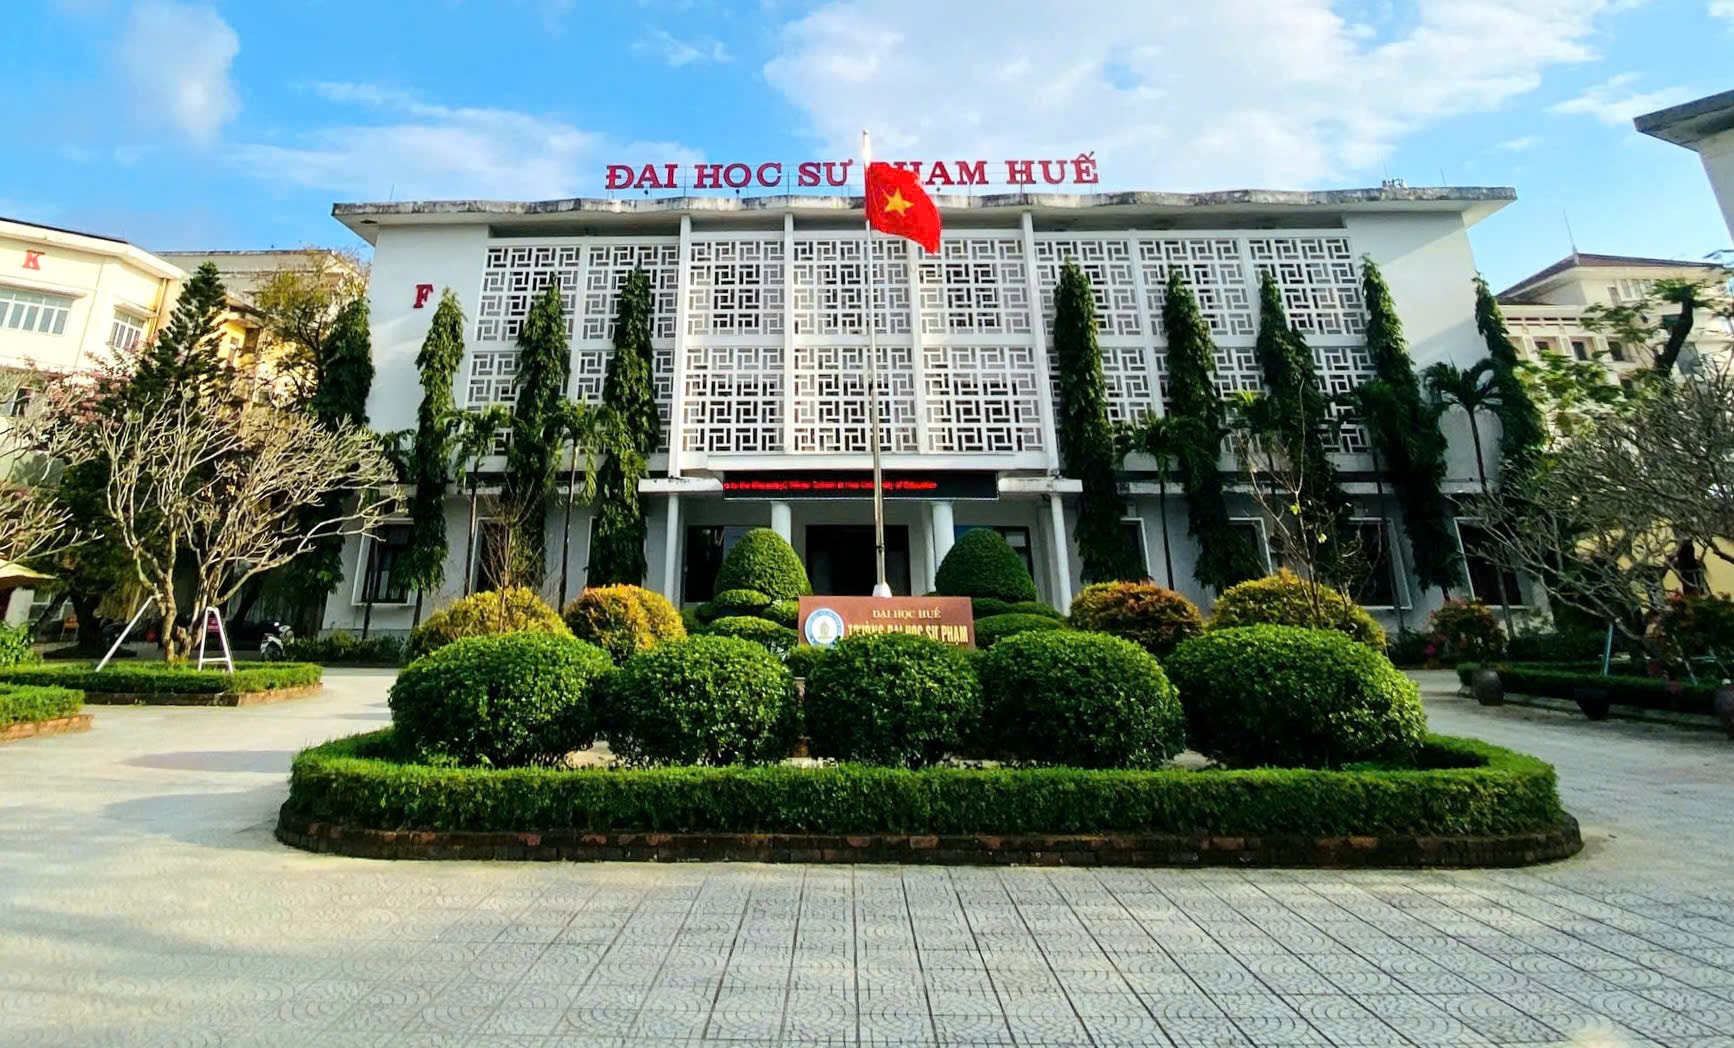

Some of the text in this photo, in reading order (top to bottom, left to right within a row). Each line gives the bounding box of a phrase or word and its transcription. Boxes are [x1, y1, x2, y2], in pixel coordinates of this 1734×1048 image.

[605, 163, 678, 195] ĐẠI
[693, 161, 782, 194] HỌC
[798, 158, 853, 187] SƯ
[1004, 151, 1099, 185] HUẾ
[22, 249, 44, 270] K
[413, 283, 434, 309] F
[918, 606, 942, 619] HUẾ
[940, 624, 969, 646] PHẠM
